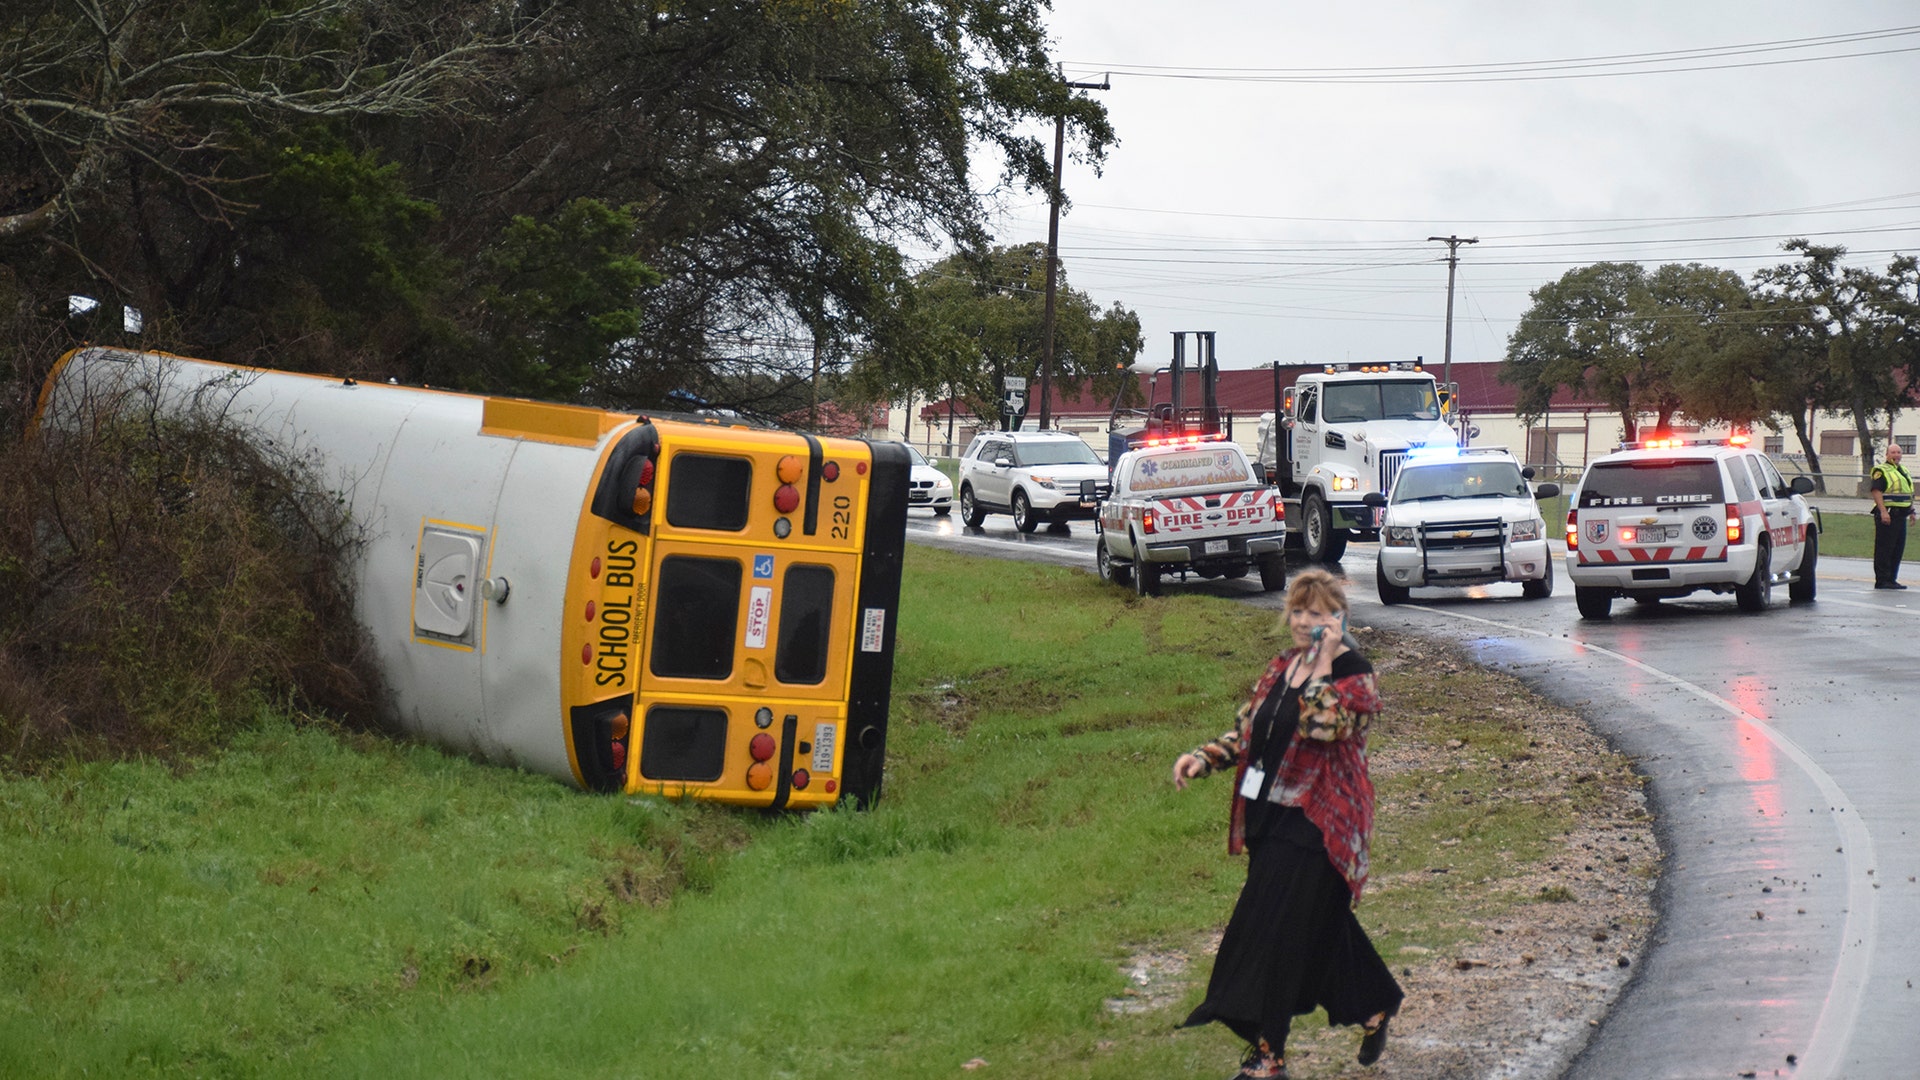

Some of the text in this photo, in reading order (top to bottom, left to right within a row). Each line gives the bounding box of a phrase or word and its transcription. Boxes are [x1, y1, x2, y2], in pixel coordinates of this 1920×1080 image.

[1007, 379, 1025, 387] NORTH
[1161, 457, 1213, 470] COMMAND
[1590, 494, 1713, 506] FIRE CHIEF
[831, 495, 850, 540] 220
[1163, 513, 1202, 527] FIRE
[1227, 507, 1265, 520] DEPT
[595, 540, 638, 687] SCHOOL BUS
[632, 582, 646, 645] EMERGENCY DOOR
[752, 598, 764, 636] STOP
